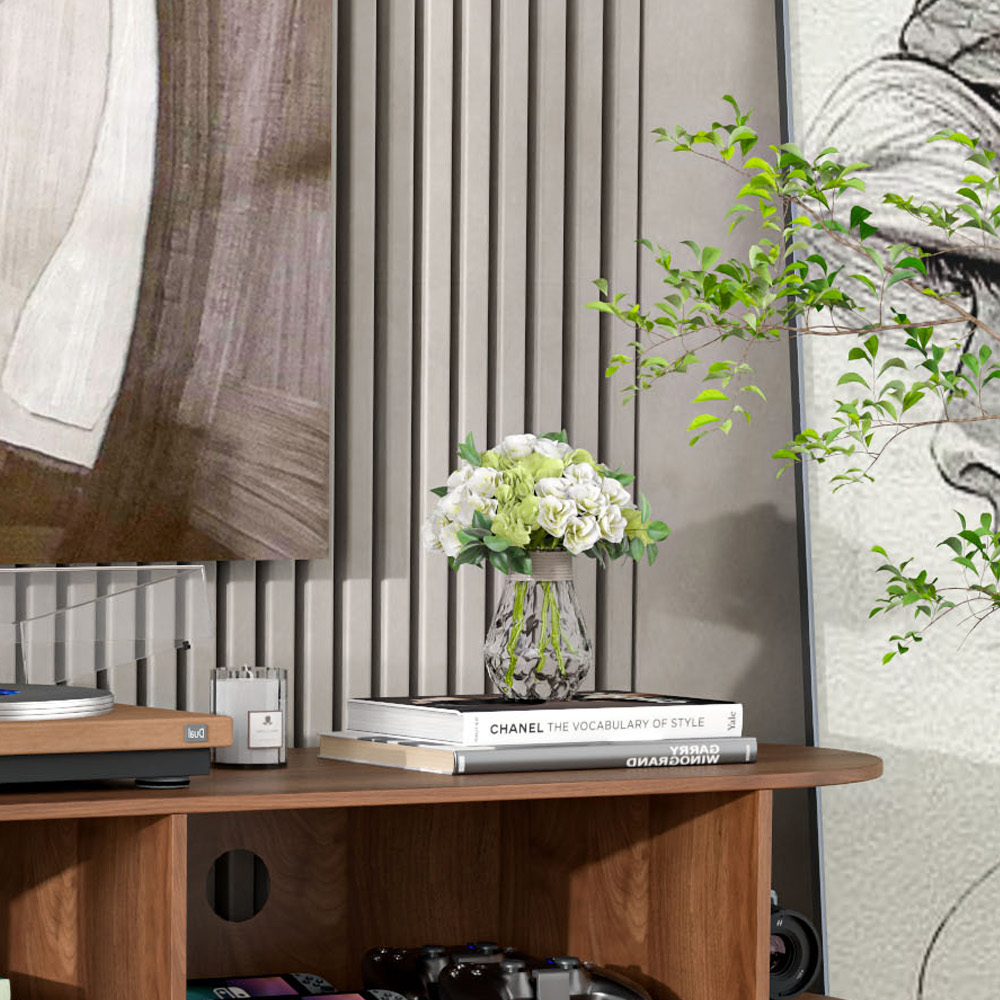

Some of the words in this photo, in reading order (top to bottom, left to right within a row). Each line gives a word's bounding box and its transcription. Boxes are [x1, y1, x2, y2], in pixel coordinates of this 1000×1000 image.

[489, 722, 545, 735] CHANEL
[548, 721, 569, 732] THE
[573, 719, 649, 732] VOCABULARY
[653, 718, 668, 728] OF
[671, 717, 705, 728] STYLE
[727, 711, 737, 731] Yale
